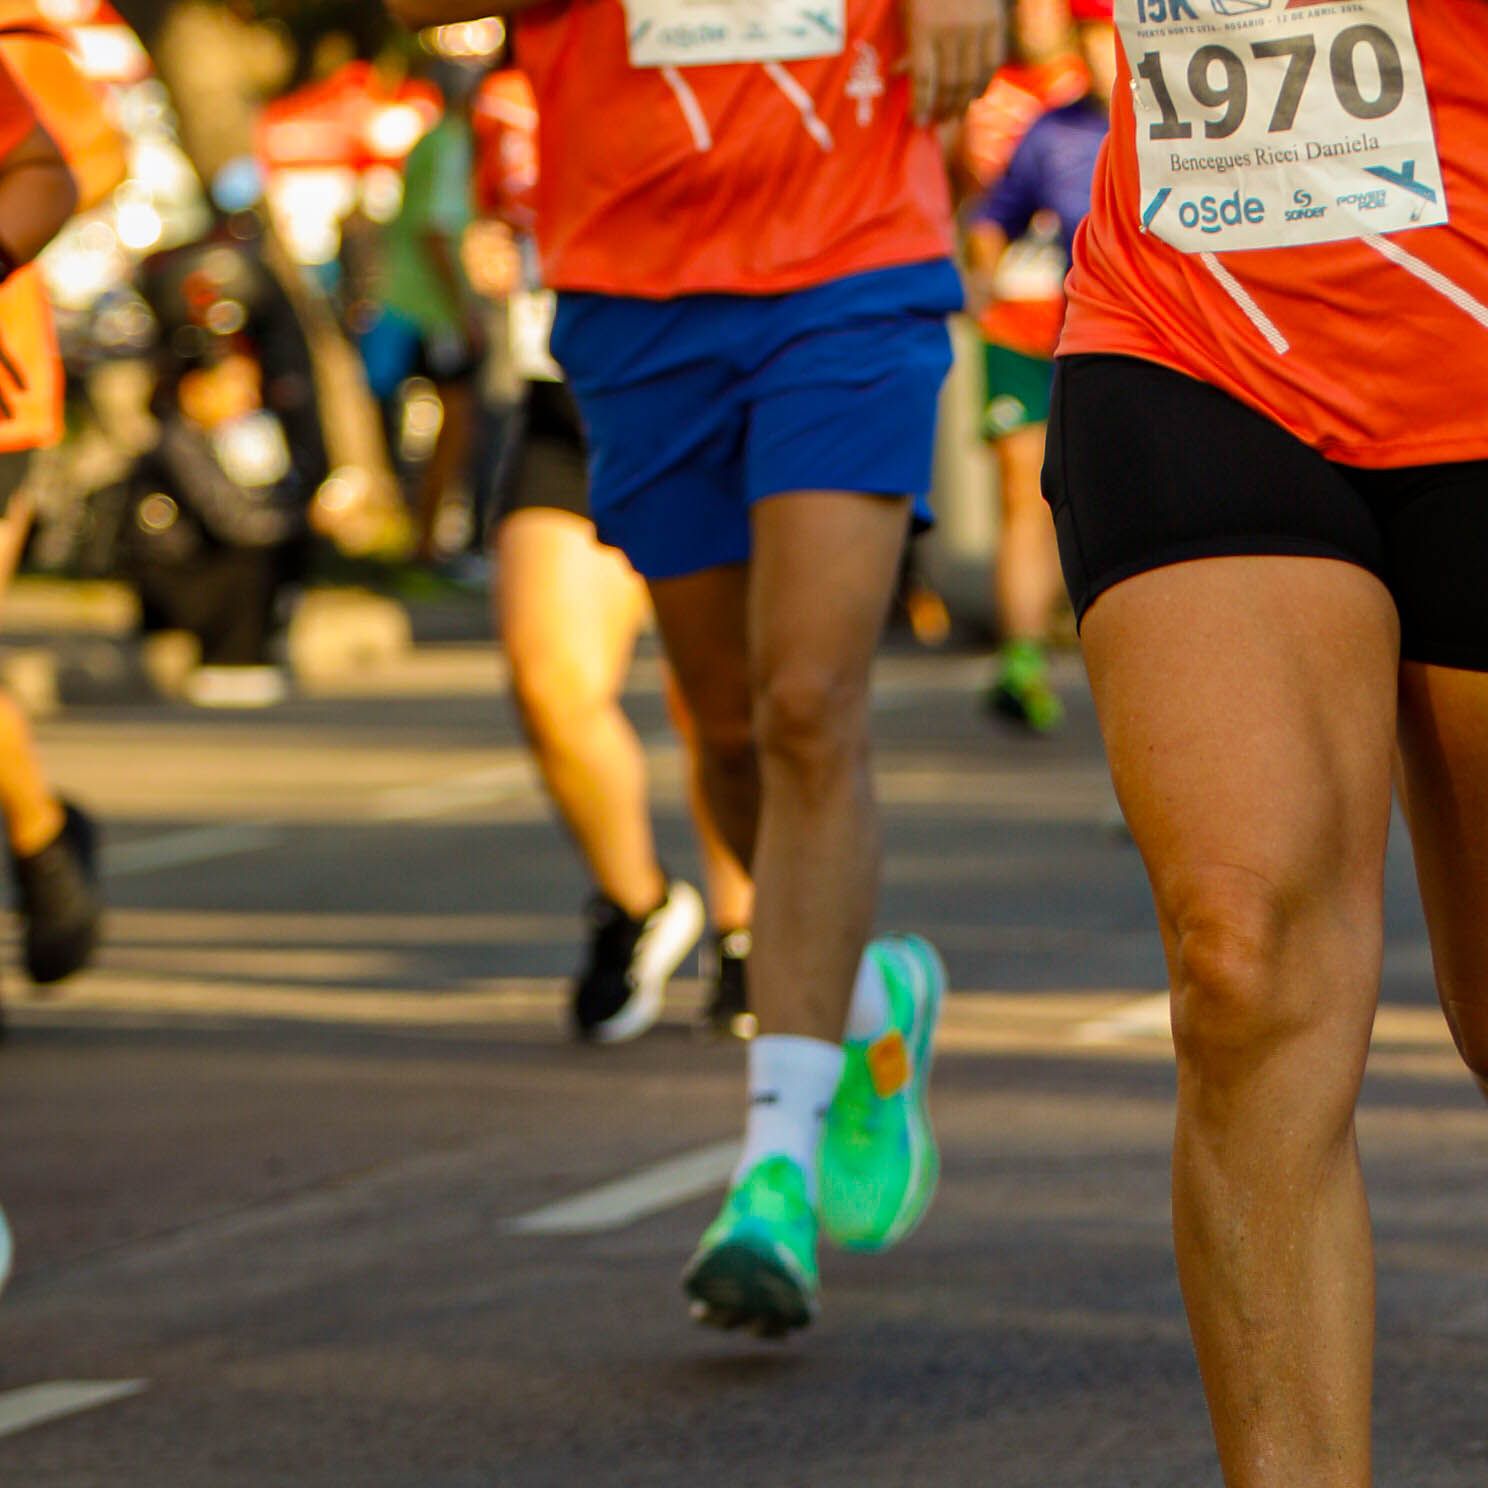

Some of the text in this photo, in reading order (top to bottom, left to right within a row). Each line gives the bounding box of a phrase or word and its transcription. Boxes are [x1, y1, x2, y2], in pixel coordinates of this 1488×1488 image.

[1137, 23, 1404, 140] 1970
[1169, 132, 1380, 173] Bencegues Ricci Daniela
[1178, 188, 1265, 230] osde
